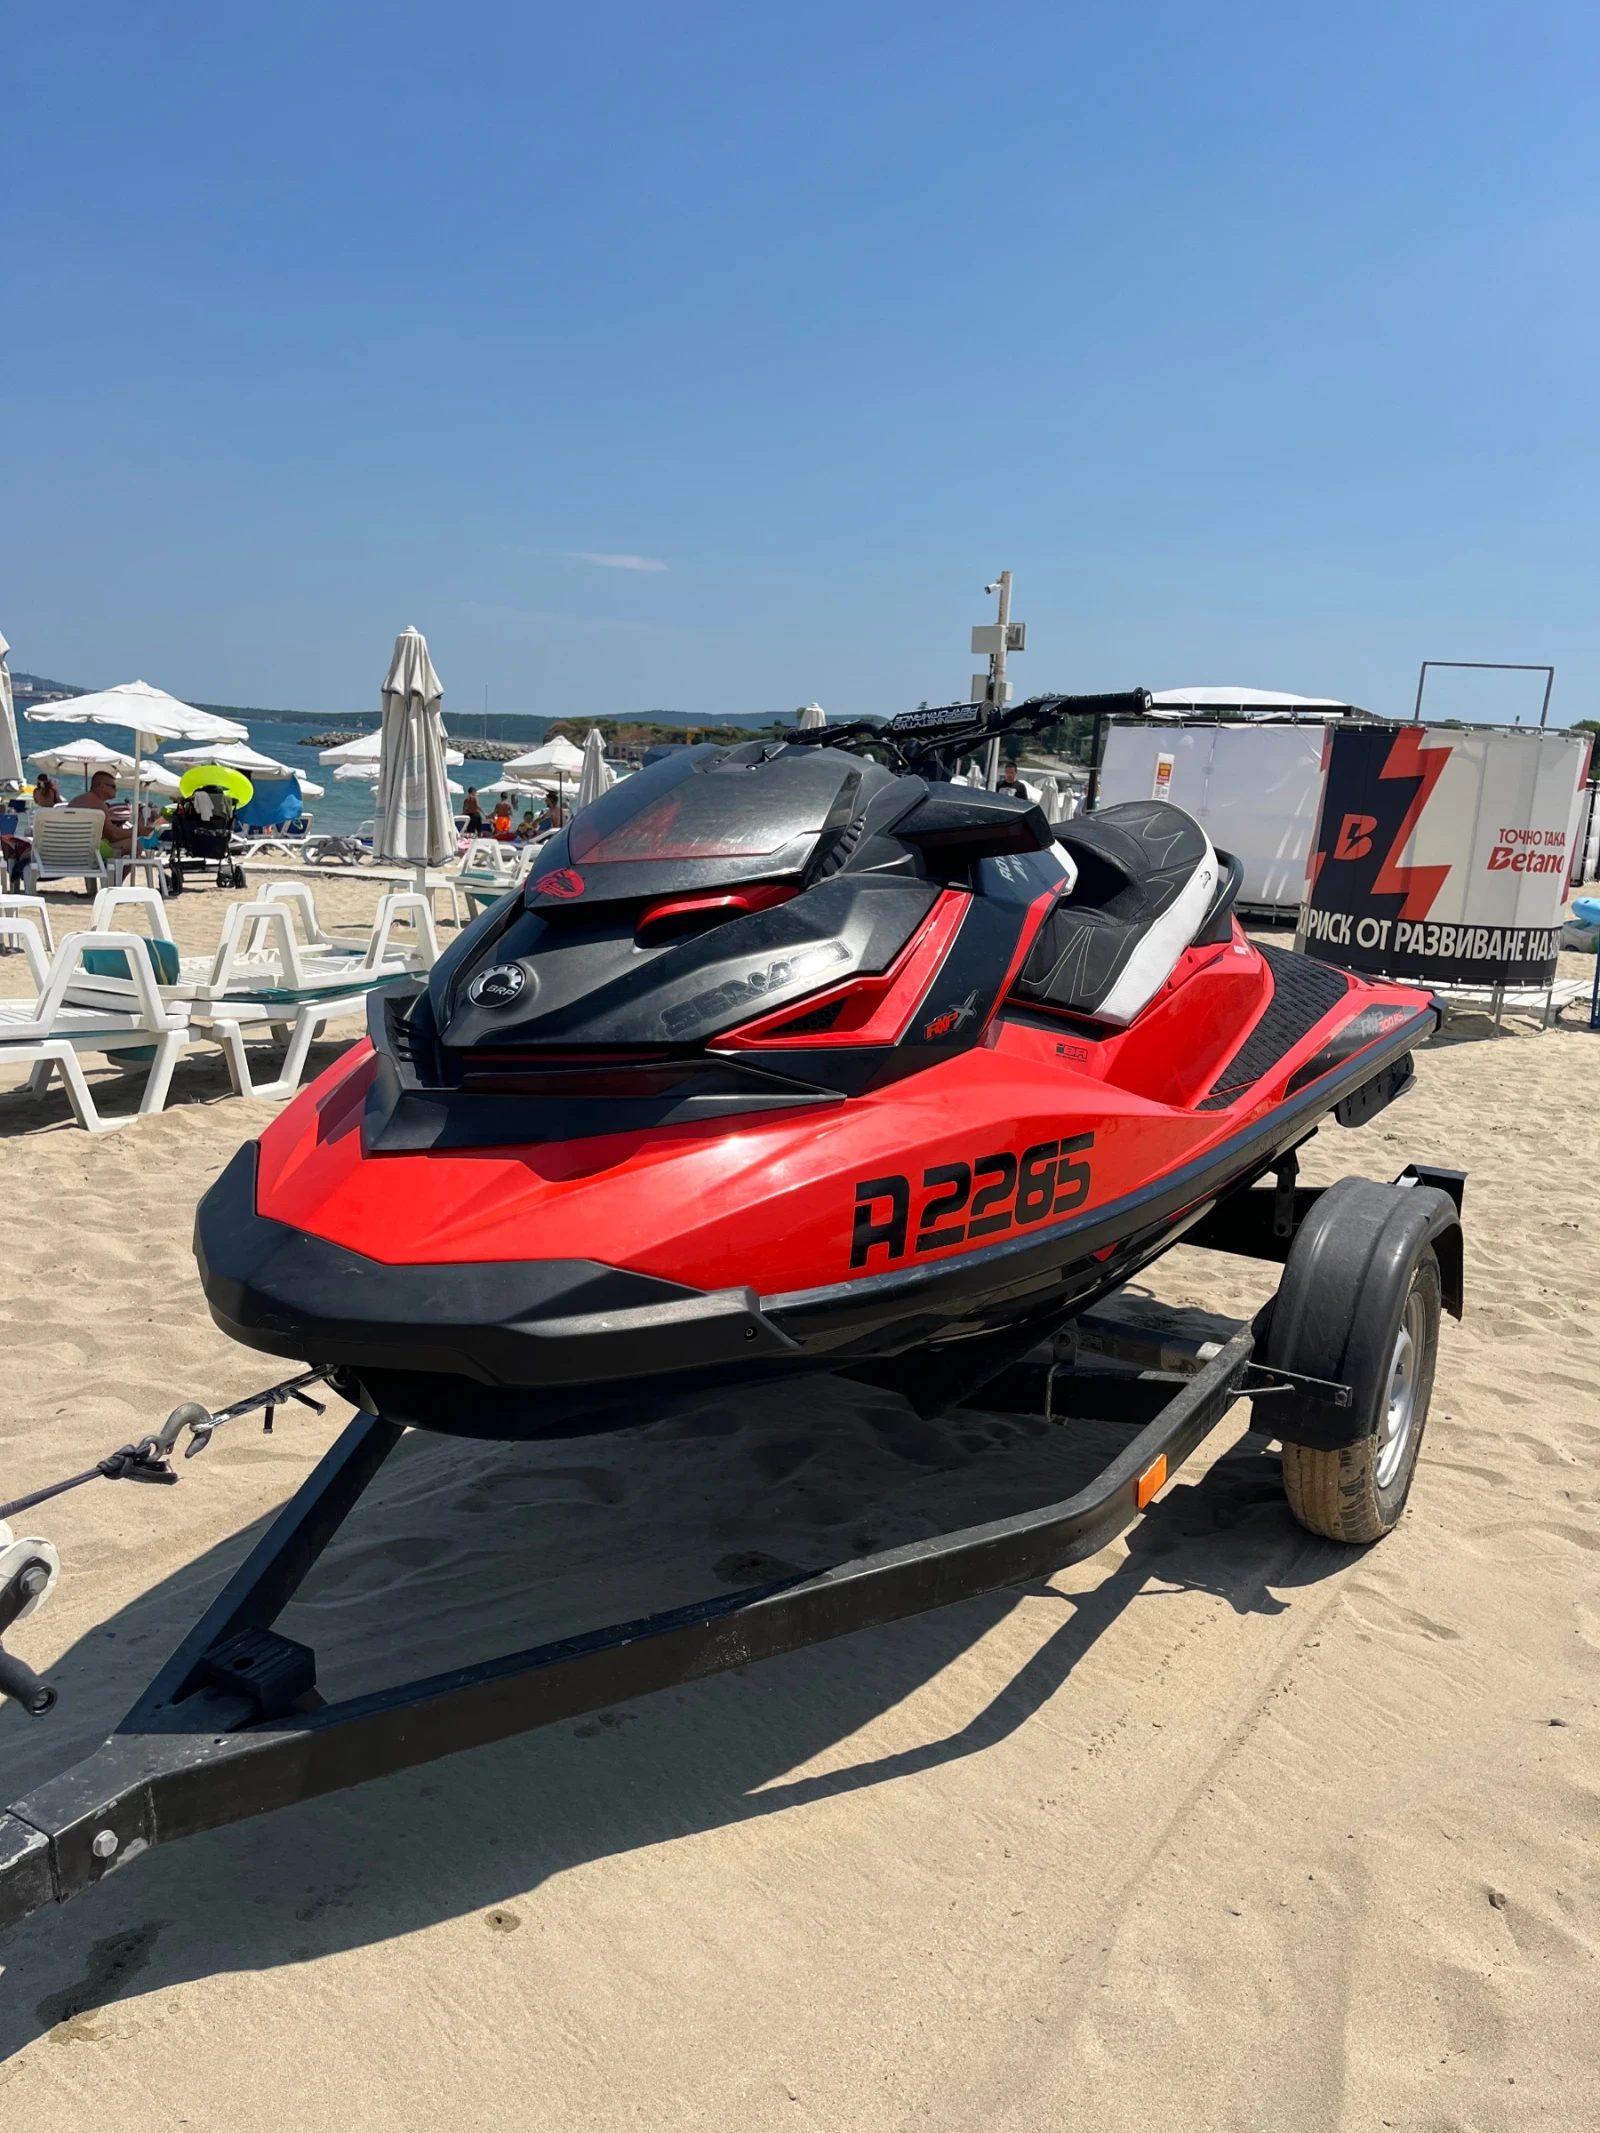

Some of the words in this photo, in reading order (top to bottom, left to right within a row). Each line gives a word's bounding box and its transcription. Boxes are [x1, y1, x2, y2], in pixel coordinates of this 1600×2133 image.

[895, 706, 979, 724] PERFORMANCE
[1499, 828, 1542, 846] ТОЧНО
[1544, 831, 1566, 847] ТАКА
[1487, 846, 1565, 874] Betano
[1307, 910, 1355, 946] РИСК
[1356, 917, 1392, 951] ОТ
[1394, 921, 1525, 962] РАЗВИВАНЕ
[1526, 930, 1549, 962] НА
[486, 984, 516, 996] BRP
